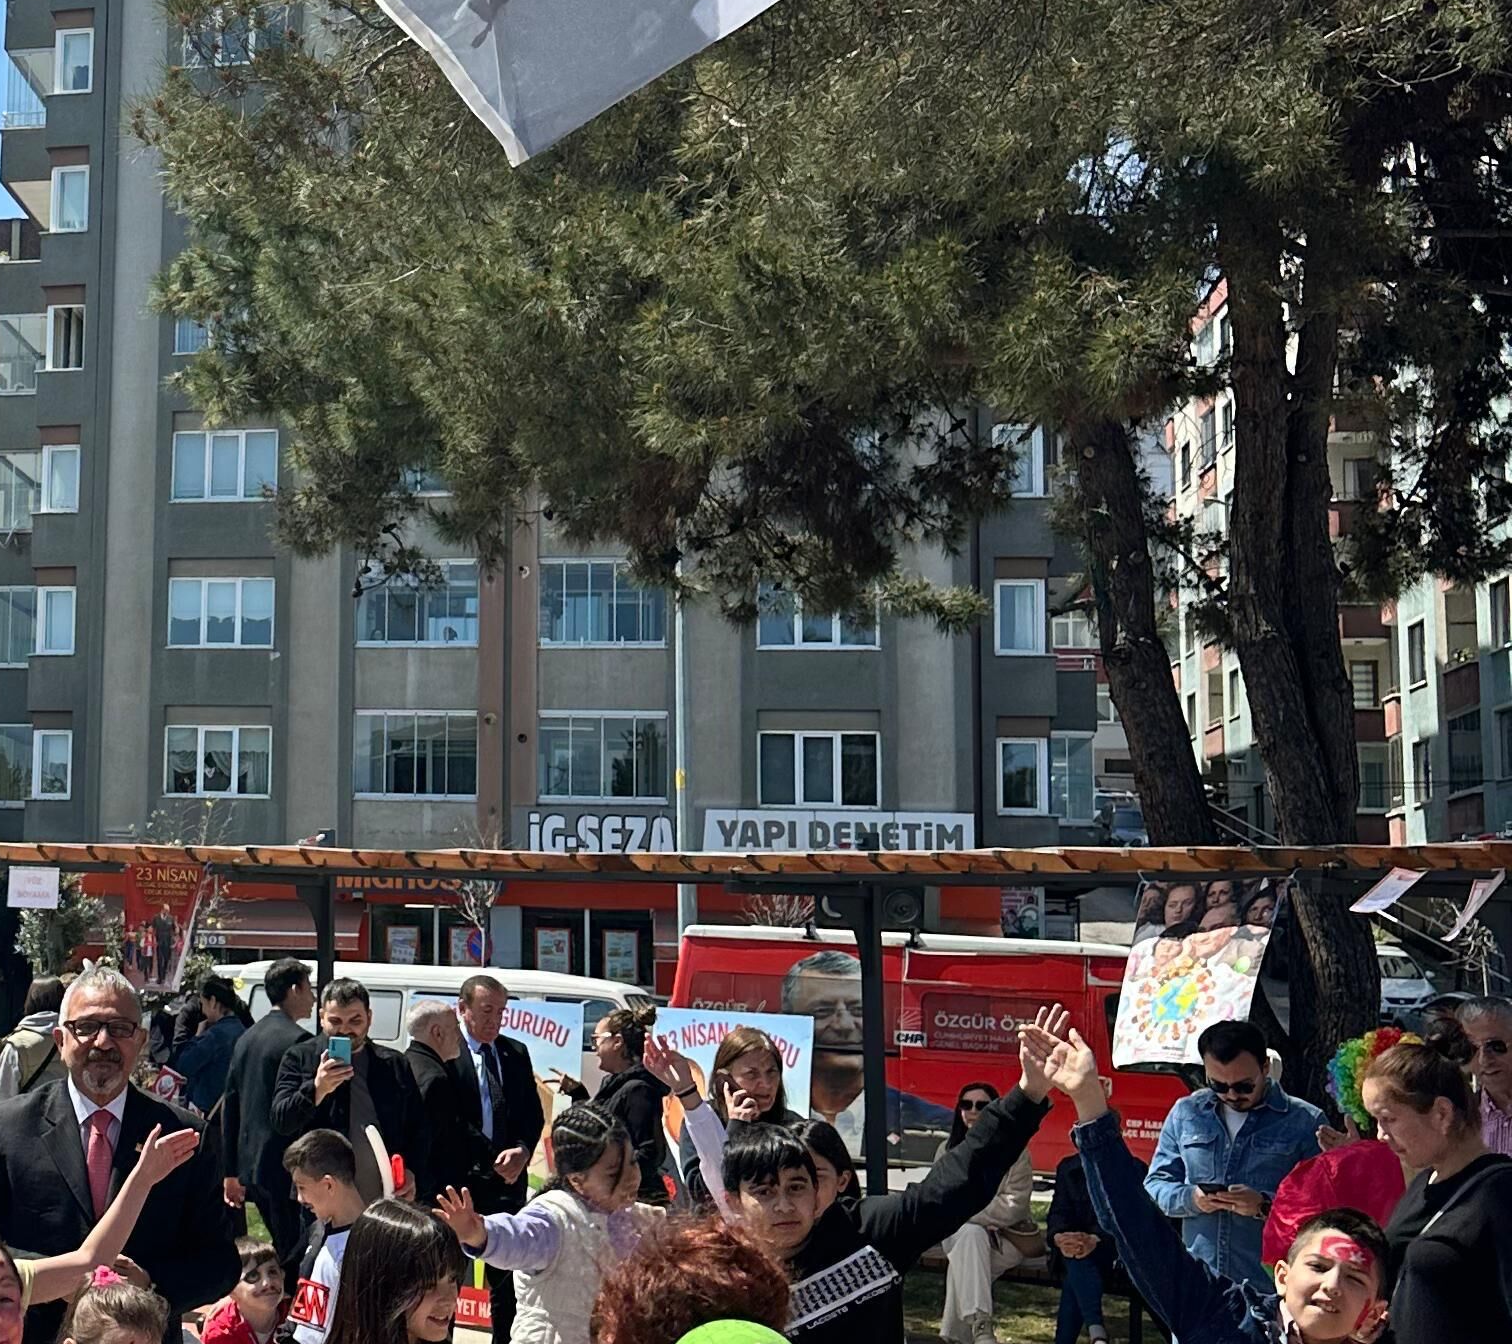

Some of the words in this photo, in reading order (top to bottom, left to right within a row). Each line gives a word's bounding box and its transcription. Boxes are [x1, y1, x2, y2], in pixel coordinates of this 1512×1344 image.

[716, 819, 797, 849] YAPI
[135, 867, 153, 881] 23
[500, 1007, 570, 1048] GURURU
[934, 1010, 997, 1030] ÖZGÜR
[896, 1032, 925, 1044] CHP
